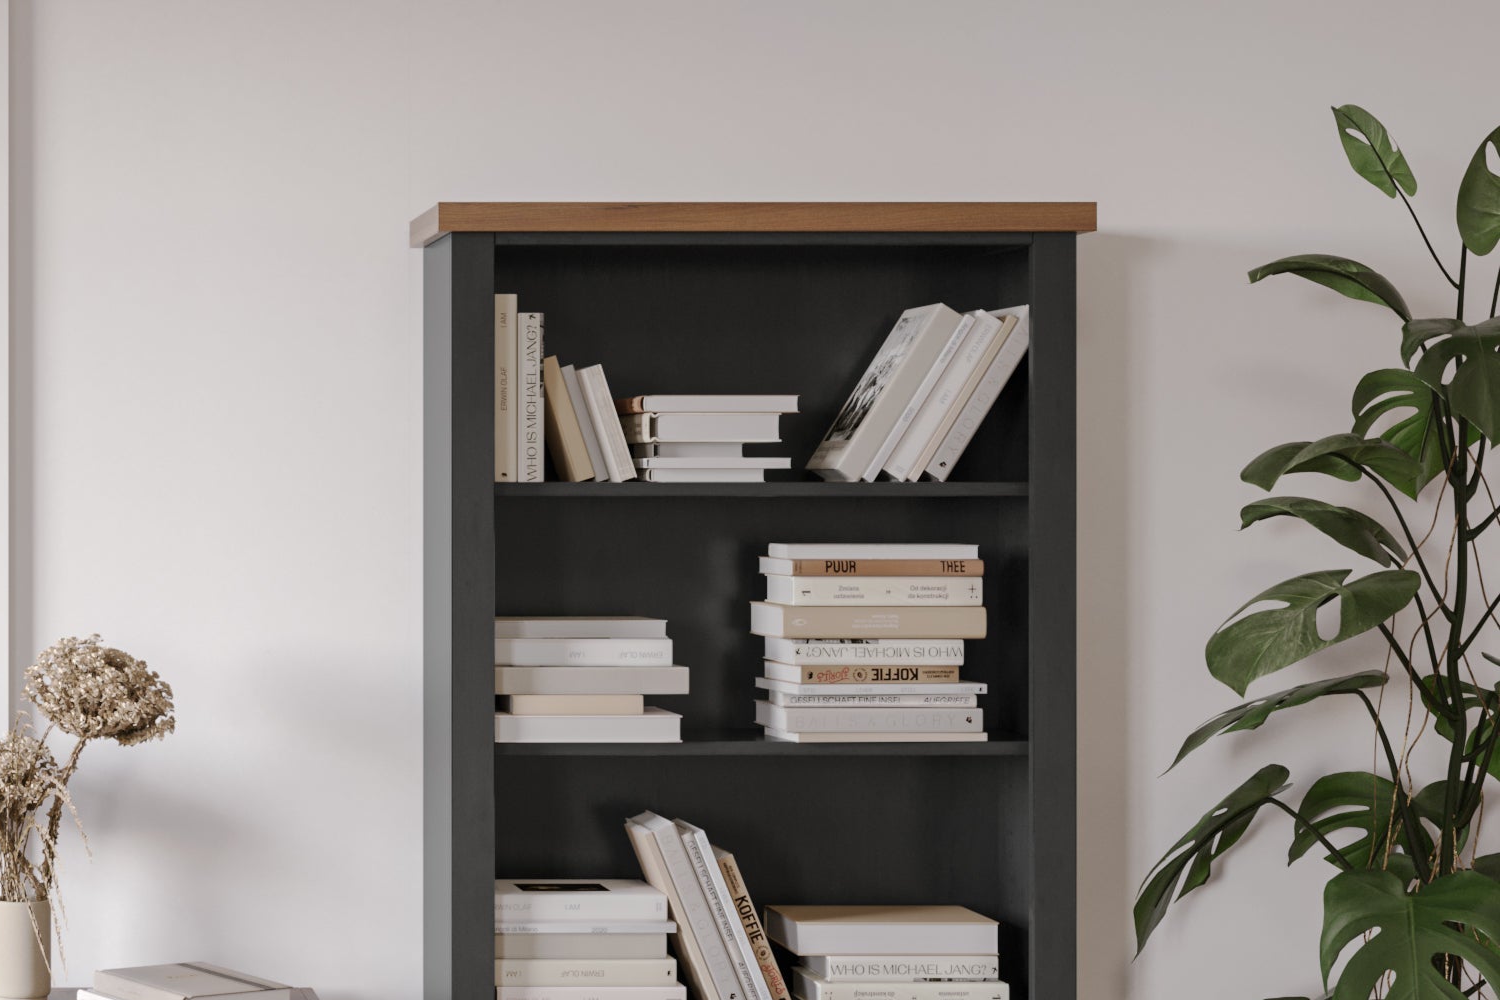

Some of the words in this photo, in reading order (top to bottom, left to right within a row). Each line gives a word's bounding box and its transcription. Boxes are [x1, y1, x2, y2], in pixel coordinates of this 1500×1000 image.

[500, 313, 508, 324] AM
[526, 325, 538, 366] JANG?
[500, 366, 508, 386] OLAF
[500, 387, 508, 410] ERWIN
[526, 368, 538, 429] MICHAEL
[526, 431, 538, 444] IS
[526, 446, 538, 482] WHO
[825, 560, 857, 573] PUUR
[940, 560, 966, 573] THEE
[806, 646, 848, 658] JANG?
[853, 646, 910, 658] MICHAEL
[912, 646, 924, 658] IS
[928, 646, 963, 658] WHO
[870, 668, 918, 680] KOFFIE
[735, 895, 765, 945] KOFFIE
[560, 970, 580, 978] OLAF
[580, 970, 605, 978] ERWIN
[830, 964, 866, 976] WHO
[868, 964, 880, 976] IS
[883, 964, 942, 976] MICHAEL
[944, 964, 987, 976] JANG?
